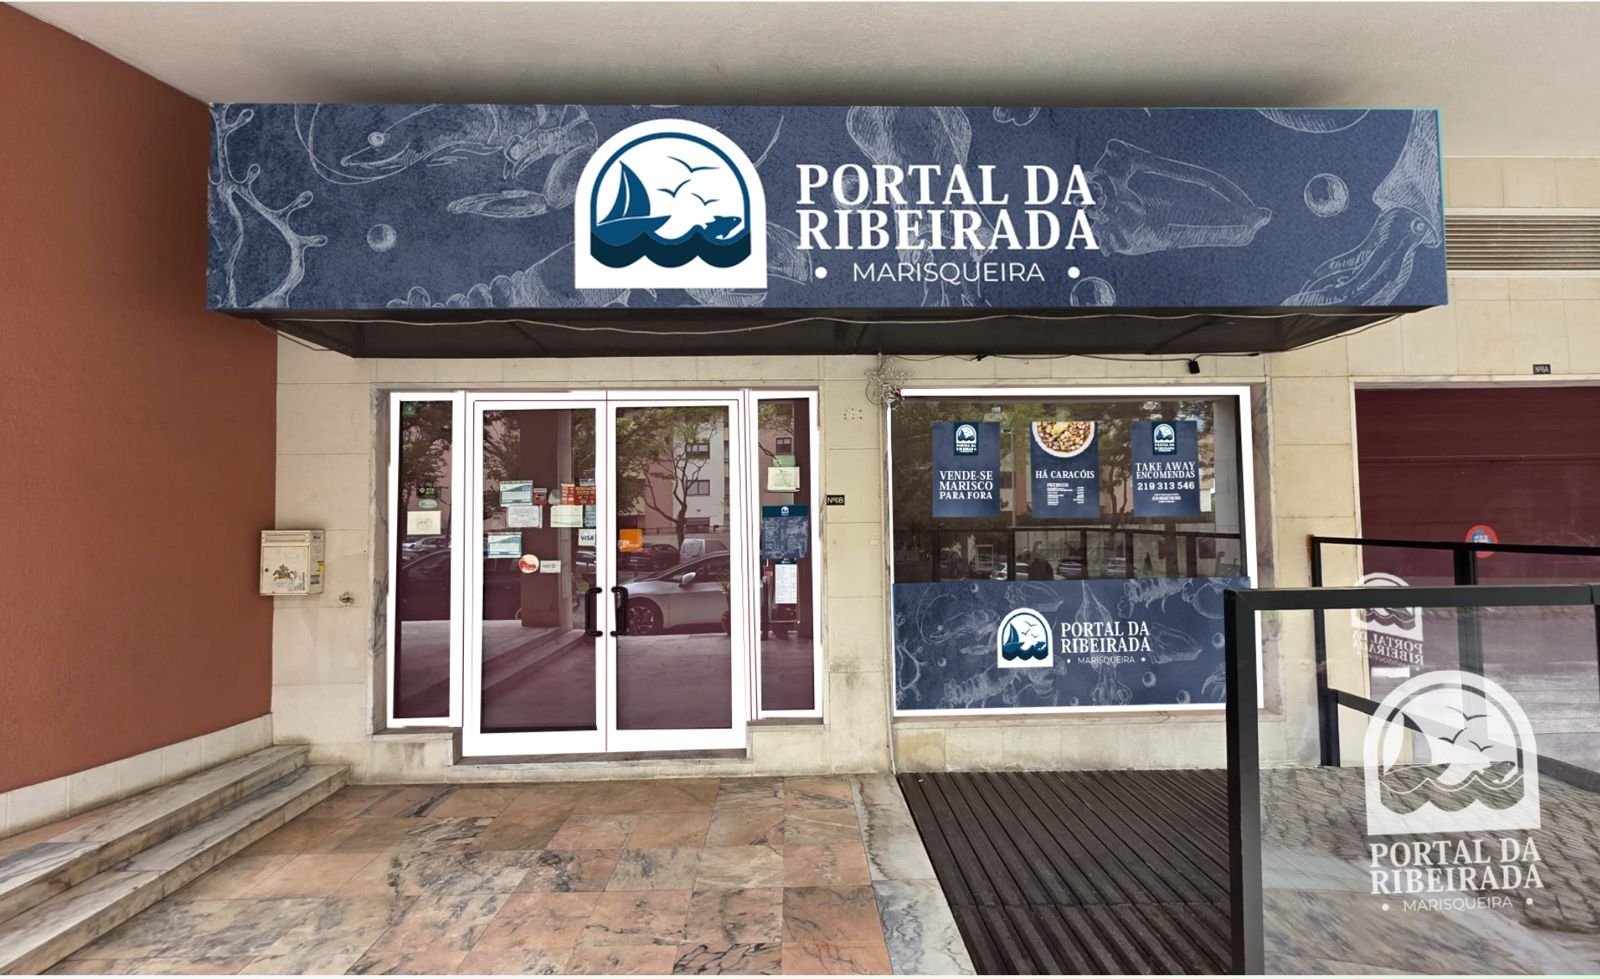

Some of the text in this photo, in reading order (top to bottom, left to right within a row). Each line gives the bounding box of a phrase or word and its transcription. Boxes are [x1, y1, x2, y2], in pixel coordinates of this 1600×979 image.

[796, 163, 1096, 205] PORTAL DA
[796, 208, 1099, 250] RIBEIRADA
[853, 262, 1046, 284] MARISQUEIRA
[1136, 461, 1196, 472] TAKE AWAY
[940, 470, 993, 480] VENDE-SE
[1035, 469, 1095, 479] HÁ CARACÓIS
[1136, 470, 1196, 479] ENCOMENDAS
[939, 481, 993, 490] MARISCO
[1137, 481, 1195, 491] 219 313 546
[940, 491, 993, 500] PARA FORA
[1060, 620, 1150, 637] PORTAL DA
[1060, 637, 1151, 653] RIBEIRADA
[1077, 656, 1136, 665] MARISQUEIRA
[1369, 837, 1541, 868] PORTAL DA
[1370, 863, 1544, 895] RIBEIRADA
[1403, 896, 1513, 912] MARISQUEIRA
